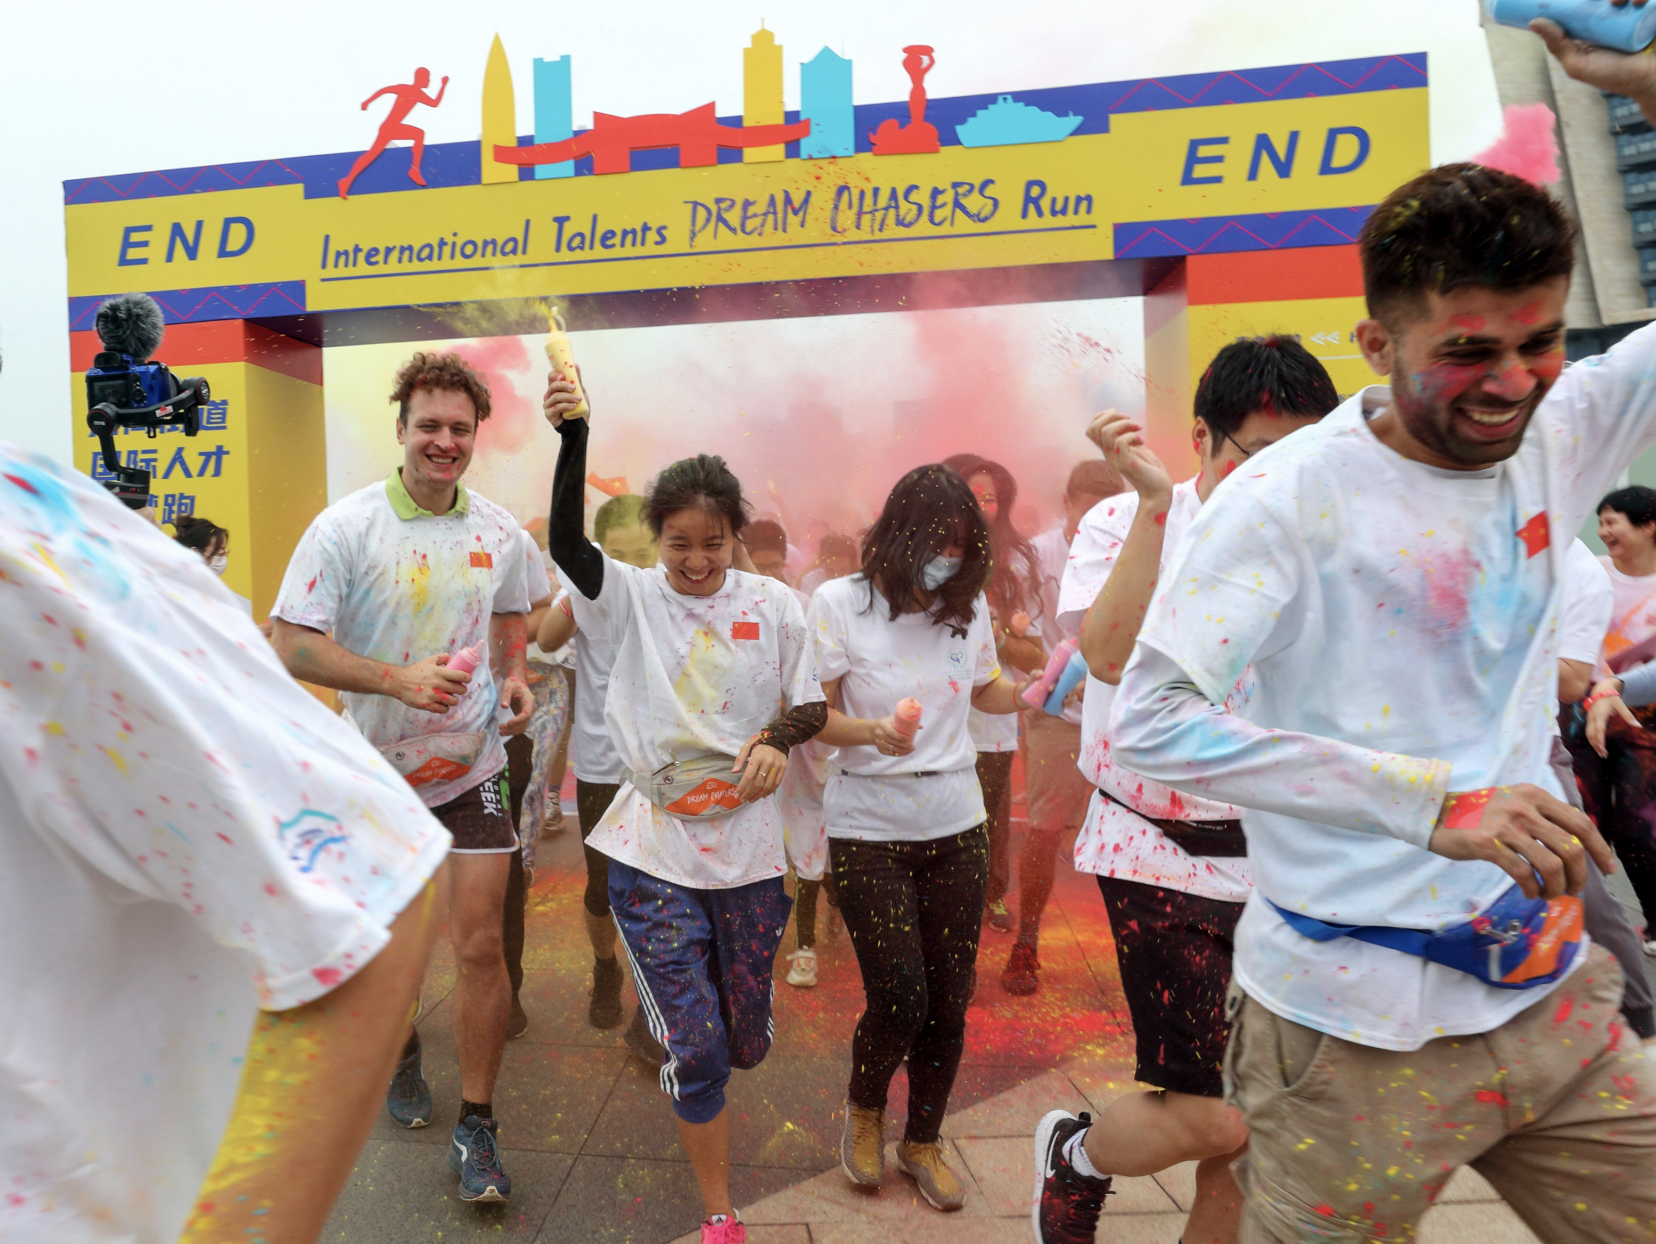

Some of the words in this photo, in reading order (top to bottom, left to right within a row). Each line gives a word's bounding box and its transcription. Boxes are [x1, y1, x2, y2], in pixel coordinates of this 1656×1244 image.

[1180, 126, 1371, 187] END
[117, 216, 256, 267] END
[320, 218, 531, 270] International
[552, 213, 669, 253] Talents
[684, 187, 811, 248] DREAM
[829, 178, 1000, 236] CHASERS
[1020, 179, 1094, 220] Run
[479, 777, 498, 817] EEK
[687, 792, 709, 805] DREAM
